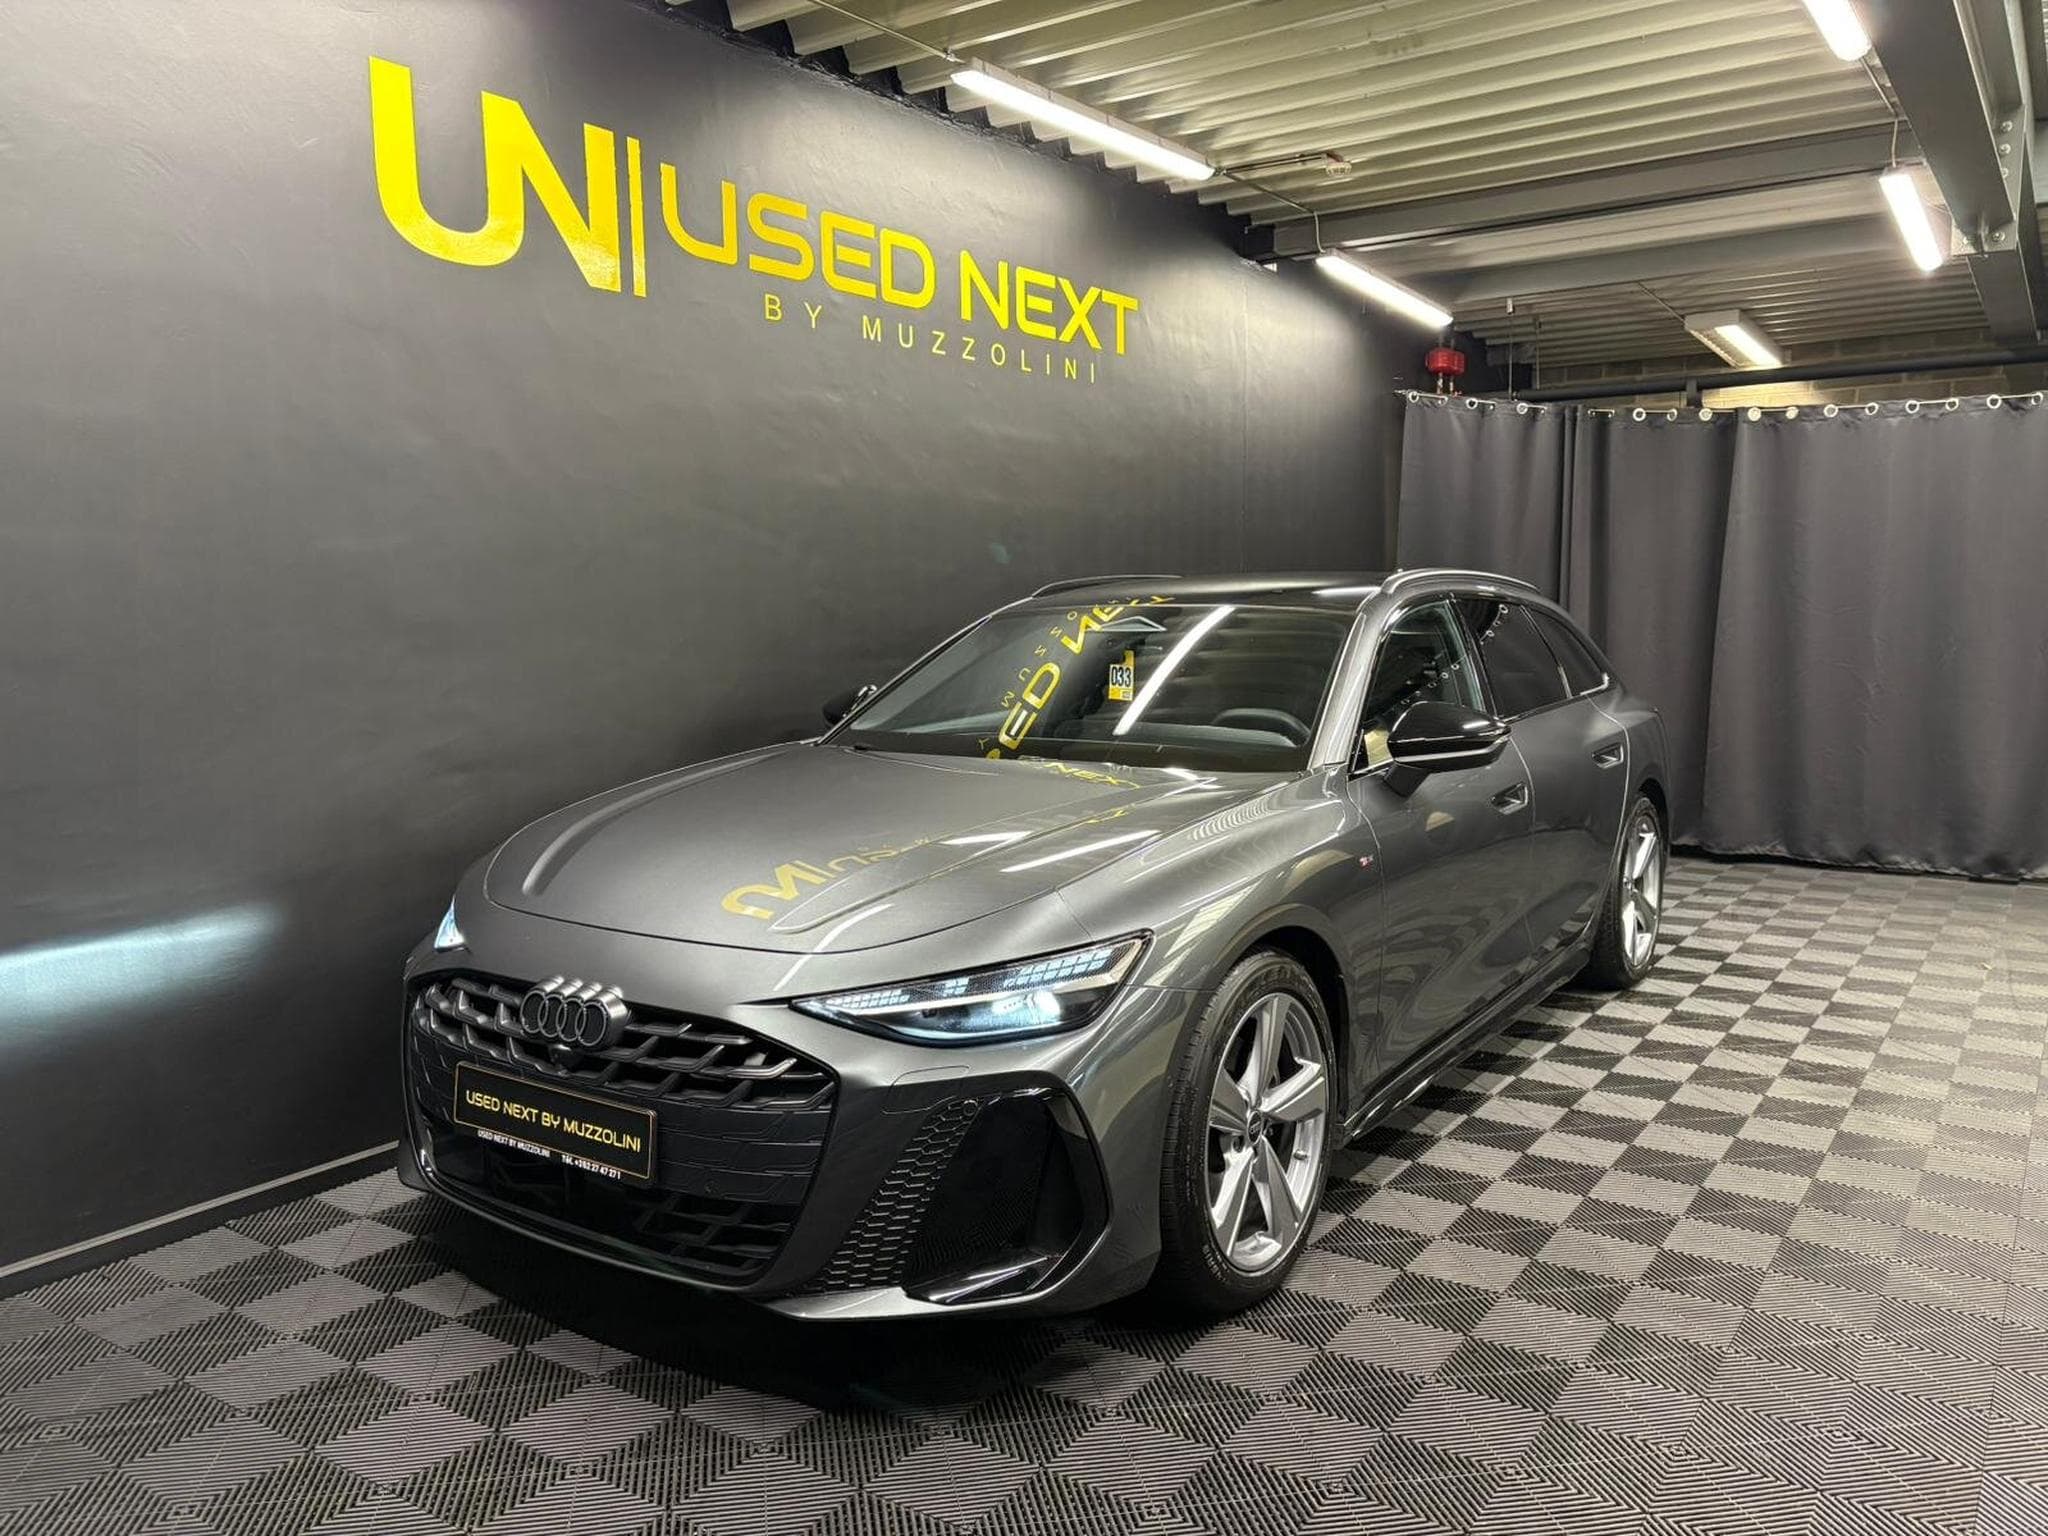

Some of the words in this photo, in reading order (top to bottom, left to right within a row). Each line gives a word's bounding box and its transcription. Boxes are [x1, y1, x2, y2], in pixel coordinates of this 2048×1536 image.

[660, 162, 936, 309] USED
[959, 249, 1139, 355] NEXT
[764, 293, 823, 329] BY
[862, 314, 1095, 384] MUZZOLINI
[1111, 666, 1131, 687] 033
[466, 1089, 500, 1112] USED
[503, 1101, 538, 1123] NEXT
[541, 1112, 561, 1129] BY
[563, 1117, 641, 1153] MUZZOLINI
